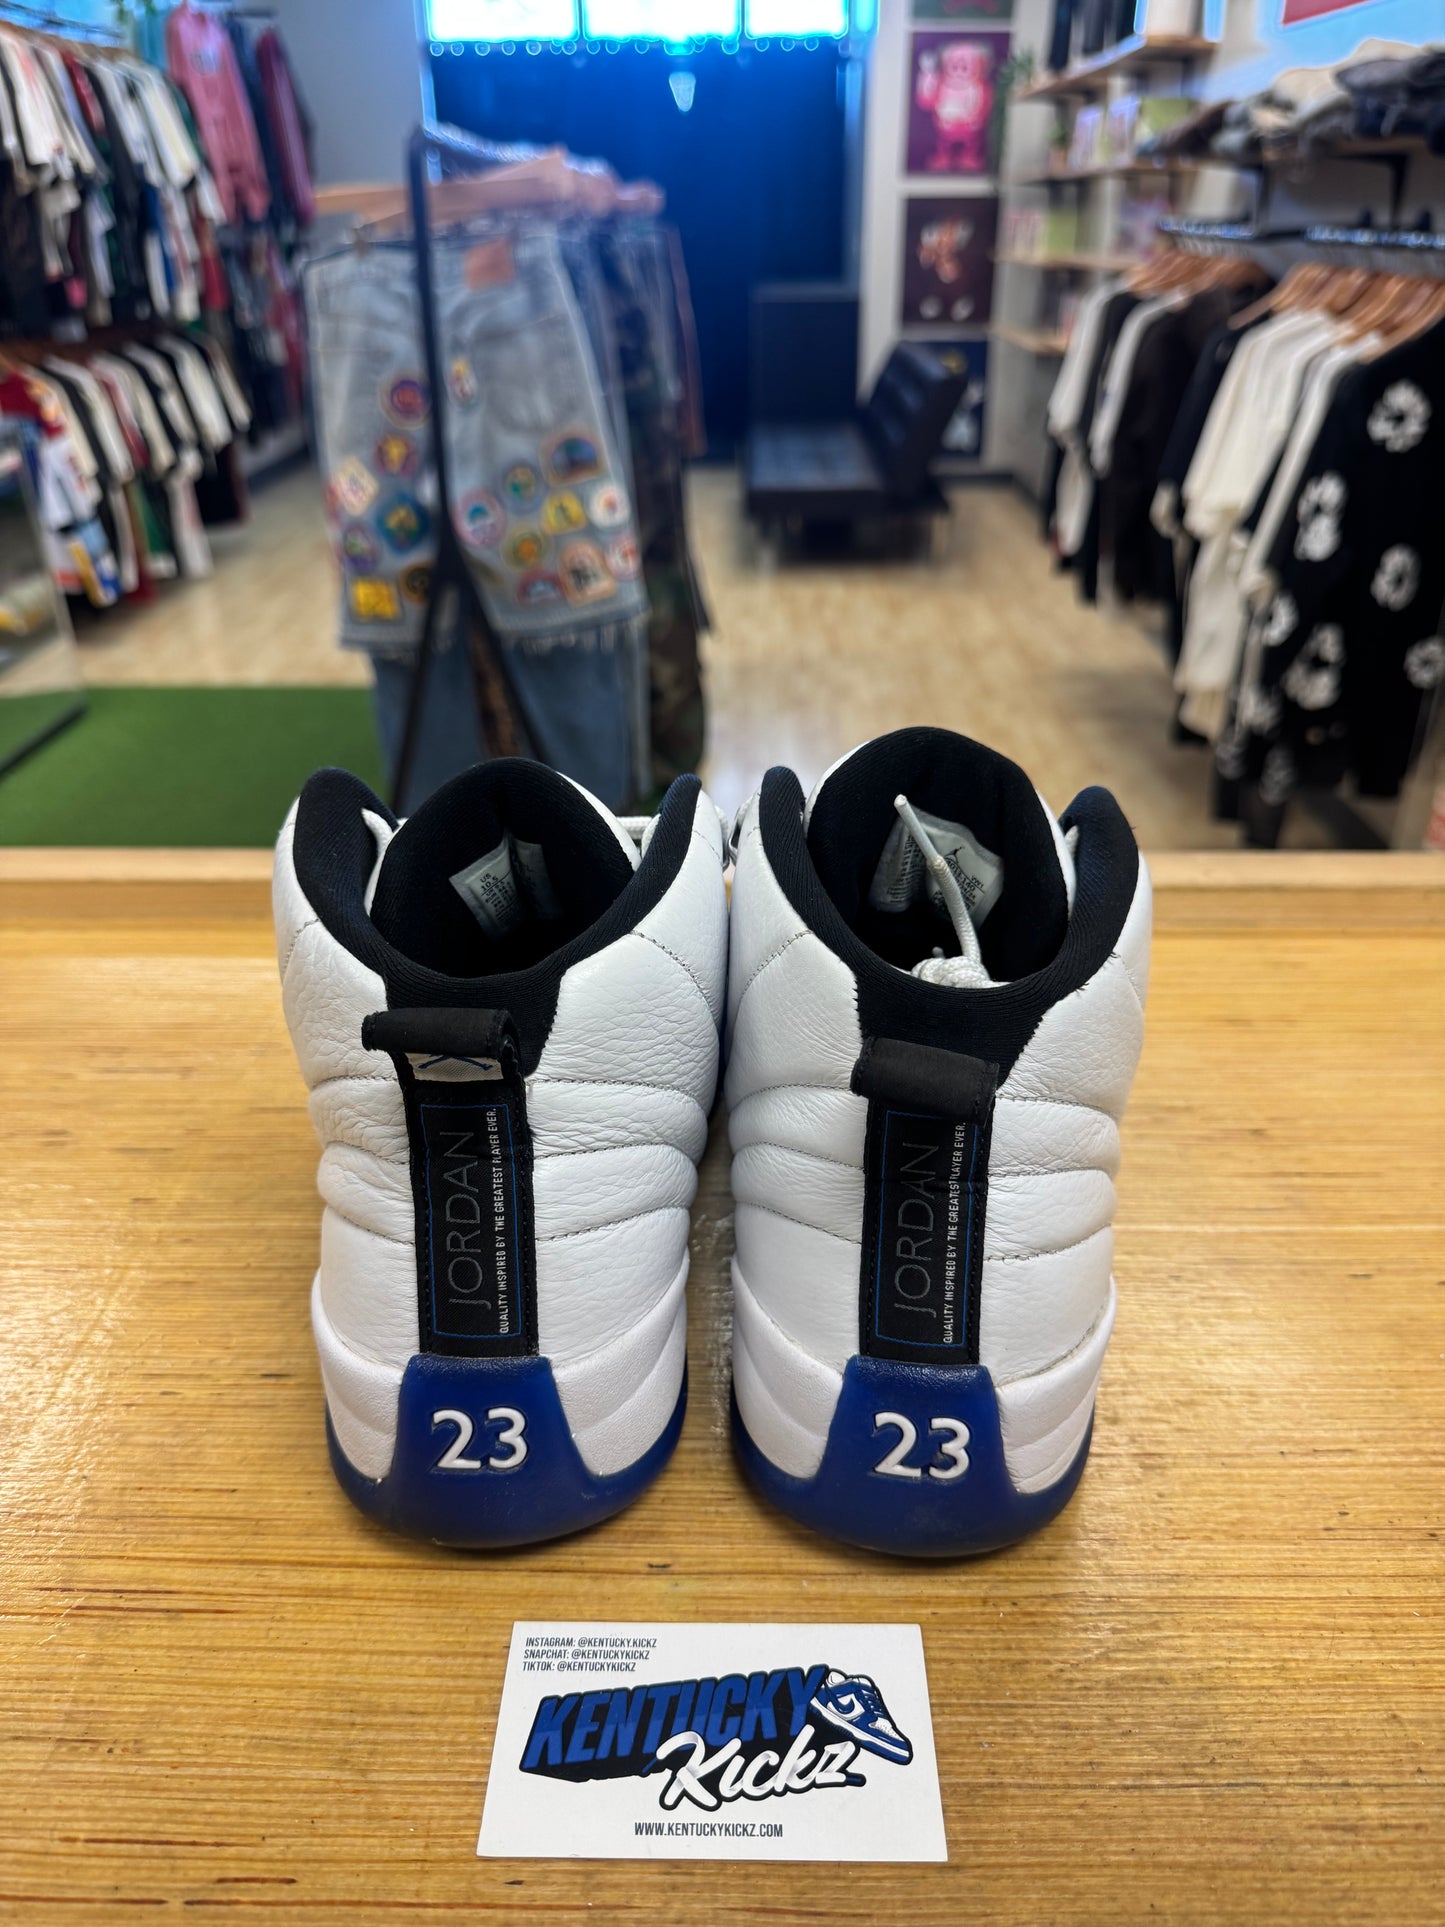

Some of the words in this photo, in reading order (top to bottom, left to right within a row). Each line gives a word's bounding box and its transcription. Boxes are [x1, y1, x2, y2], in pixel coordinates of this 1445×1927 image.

[486, 1108, 498, 1132] EVER.
[954, 1122, 967, 1148] EVER.
[492, 1167, 505, 1213] GREATEST
[948, 1180, 961, 1223] GREATEST
[440, 1131, 492, 1311] JORDAN
[494, 1215, 505, 1231] THE
[495, 1235, 506, 1248] BY
[894, 1142, 940, 1318] JORDAN
[947, 1225, 958, 1241] THE
[495, 1250, 508, 1291] INSPIRED
[946, 1245, 957, 1258] BY
[944, 1260, 956, 1301] INSPIRED
[498, 1293, 510, 1334] QUALITY
[943, 1303, 954, 1344] QUALITY
[432, 1406, 528, 1469] 23
[874, 1411, 970, 1479] 23
[523, 1649, 569, 1659] SNAPCHAT:
[571, 1649, 650, 1660] @KENTUCKYKICKZ
[525, 1637, 576, 1647] INSTAGRAM:
[577, 1637, 657, 1648] @KENTUCKY.KICKZ
[522, 1661, 555, 1671] TIKTOK:
[556, 1661, 636, 1672] @KENTUCKYKICKZ
[521, 1666, 830, 1770] KENTUCKY
[655, 1723, 857, 1808] Kickz
[634, 1822, 784, 1838] WWW.KENTUCKYKICKZ.COM
